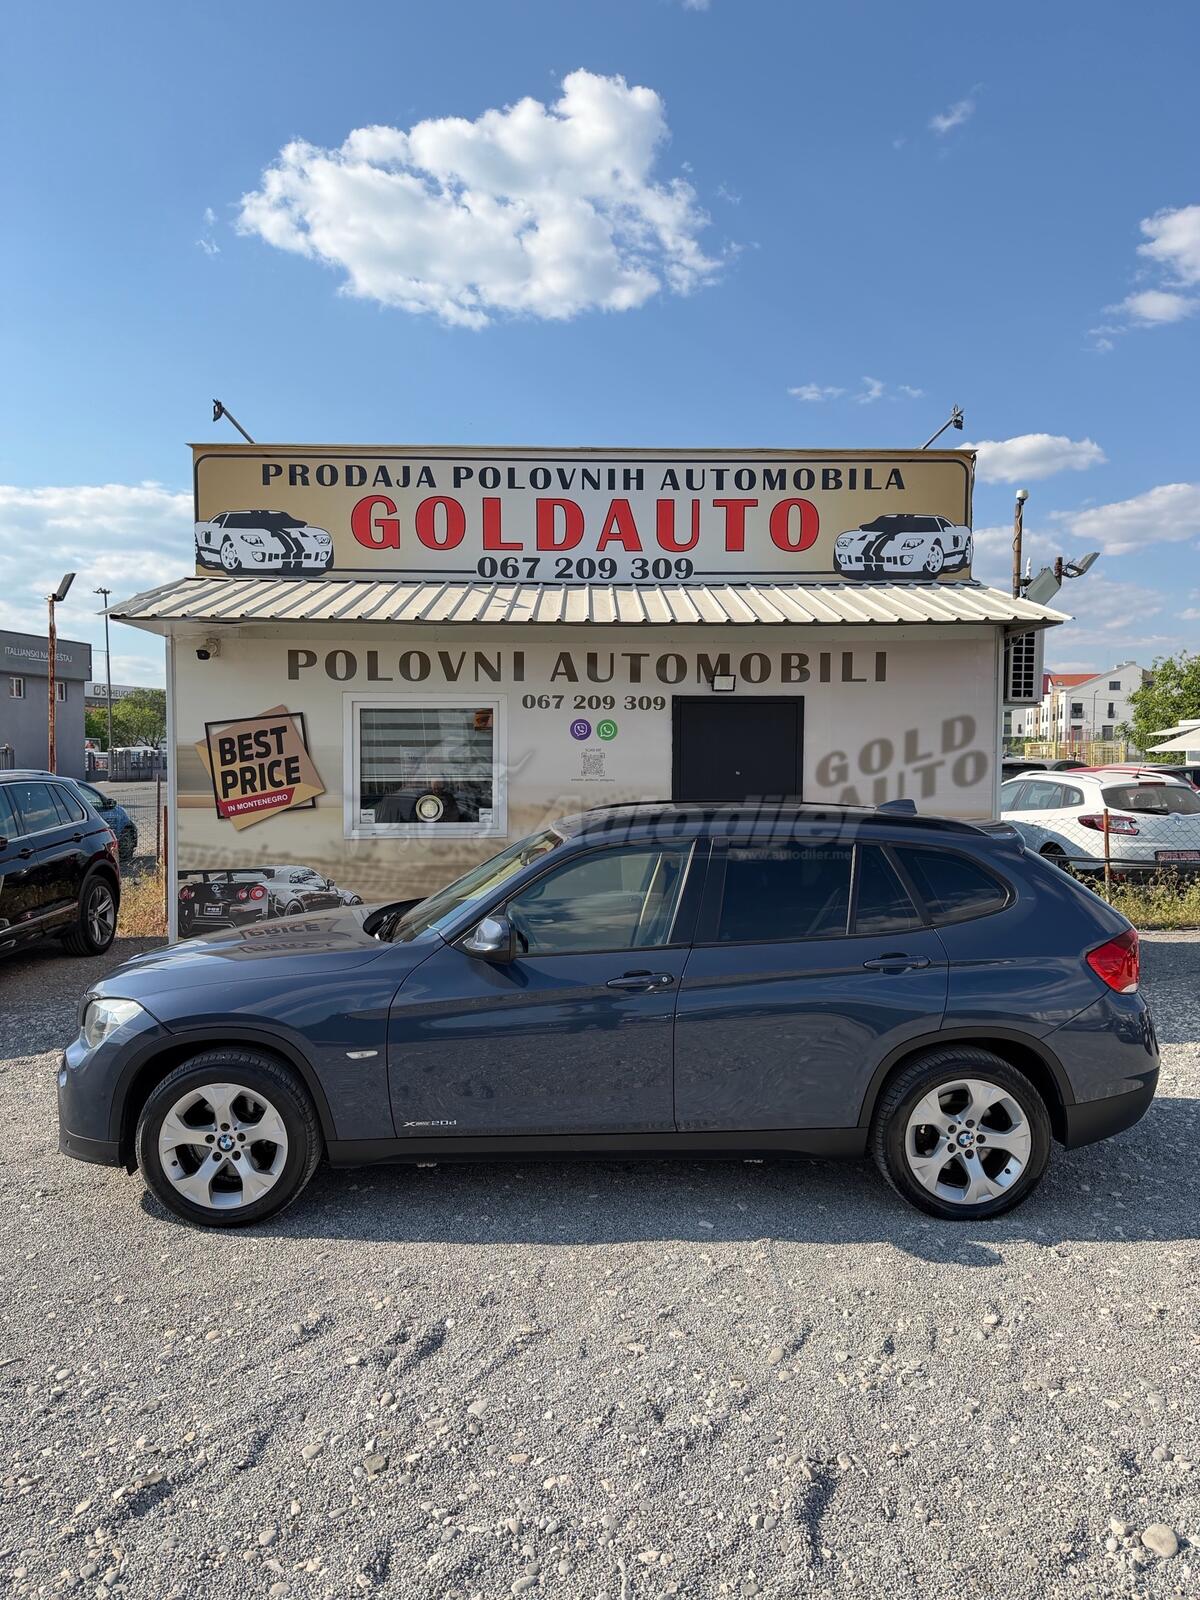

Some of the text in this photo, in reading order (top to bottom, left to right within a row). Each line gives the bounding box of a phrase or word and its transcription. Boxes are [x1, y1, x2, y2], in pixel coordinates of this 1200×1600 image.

[261, 463, 906, 491] PRODAJA POLOVNIH AUTOMOBILA
[351, 494, 820, 552] GOLDAUTO
[477, 556, 694, 579] 067 209 309
[287, 649, 887, 684] POLOVNI AUTOMOBILI
[522, 694, 666, 711] 067 209 309
[218, 725, 287, 767] BEST
[815, 714, 977, 788] GOLD
[220, 755, 301, 799] PRICE
[838, 749, 988, 806] AUTO
[227, 793, 288, 812] IN MONTENEGRO
